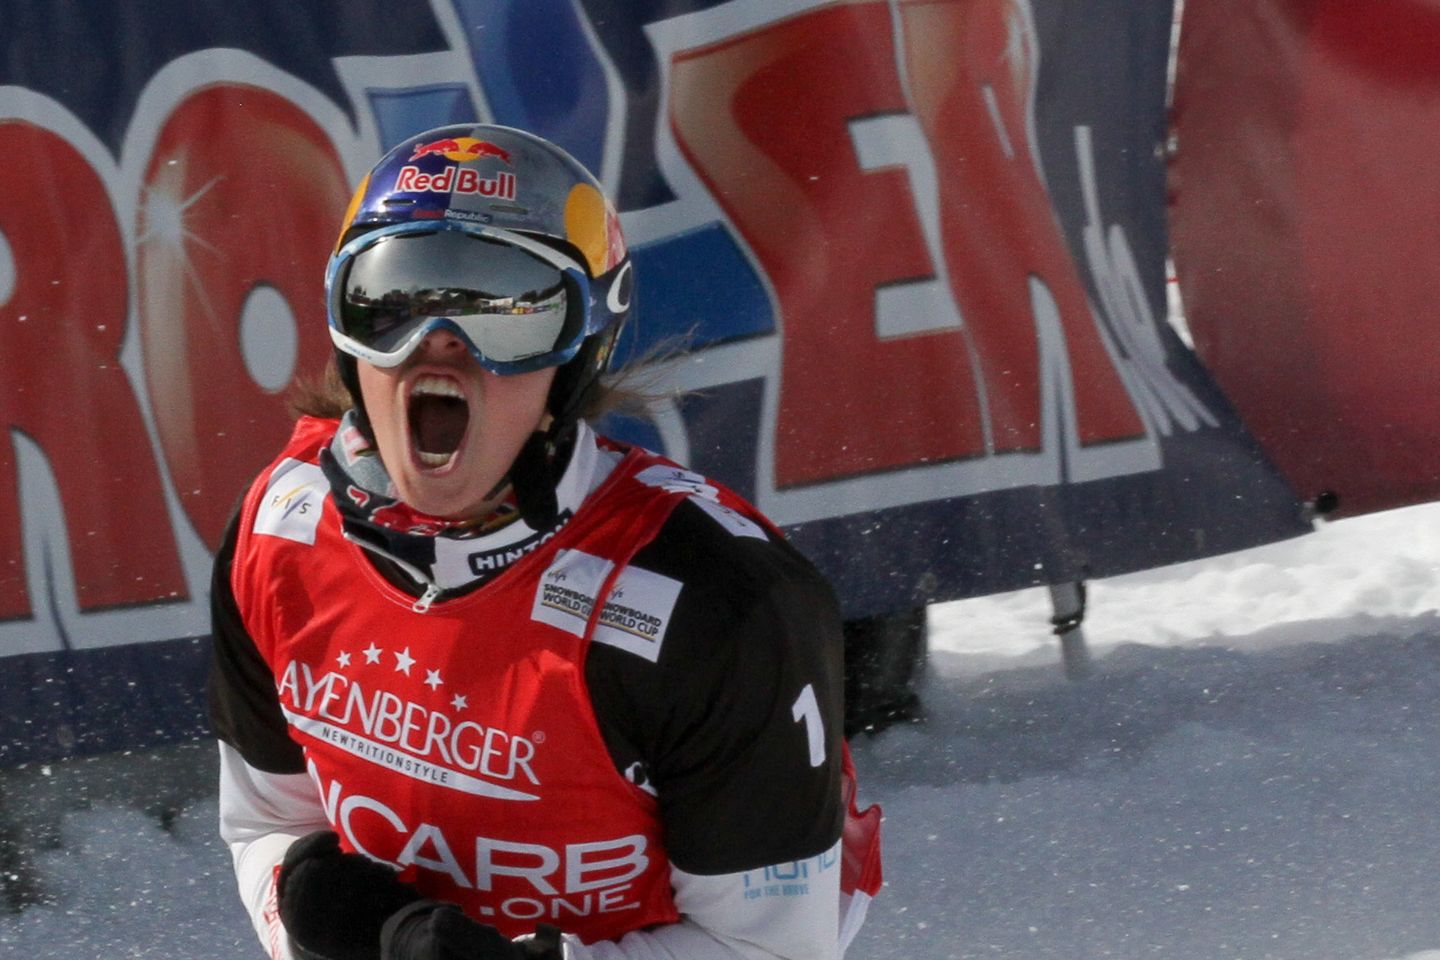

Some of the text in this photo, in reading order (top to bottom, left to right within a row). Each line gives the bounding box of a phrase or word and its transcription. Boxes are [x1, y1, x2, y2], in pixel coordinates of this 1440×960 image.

[394, 166, 516, 200] Red Bull
[543, 592, 581, 611] WORLD
[604, 601, 662, 627] NOWBOARD
[600, 610, 659, 637] WORLD CUP
[792, 683, 826, 768] 1
[321, 726, 449, 784] NEWTRITIONSTYLE
